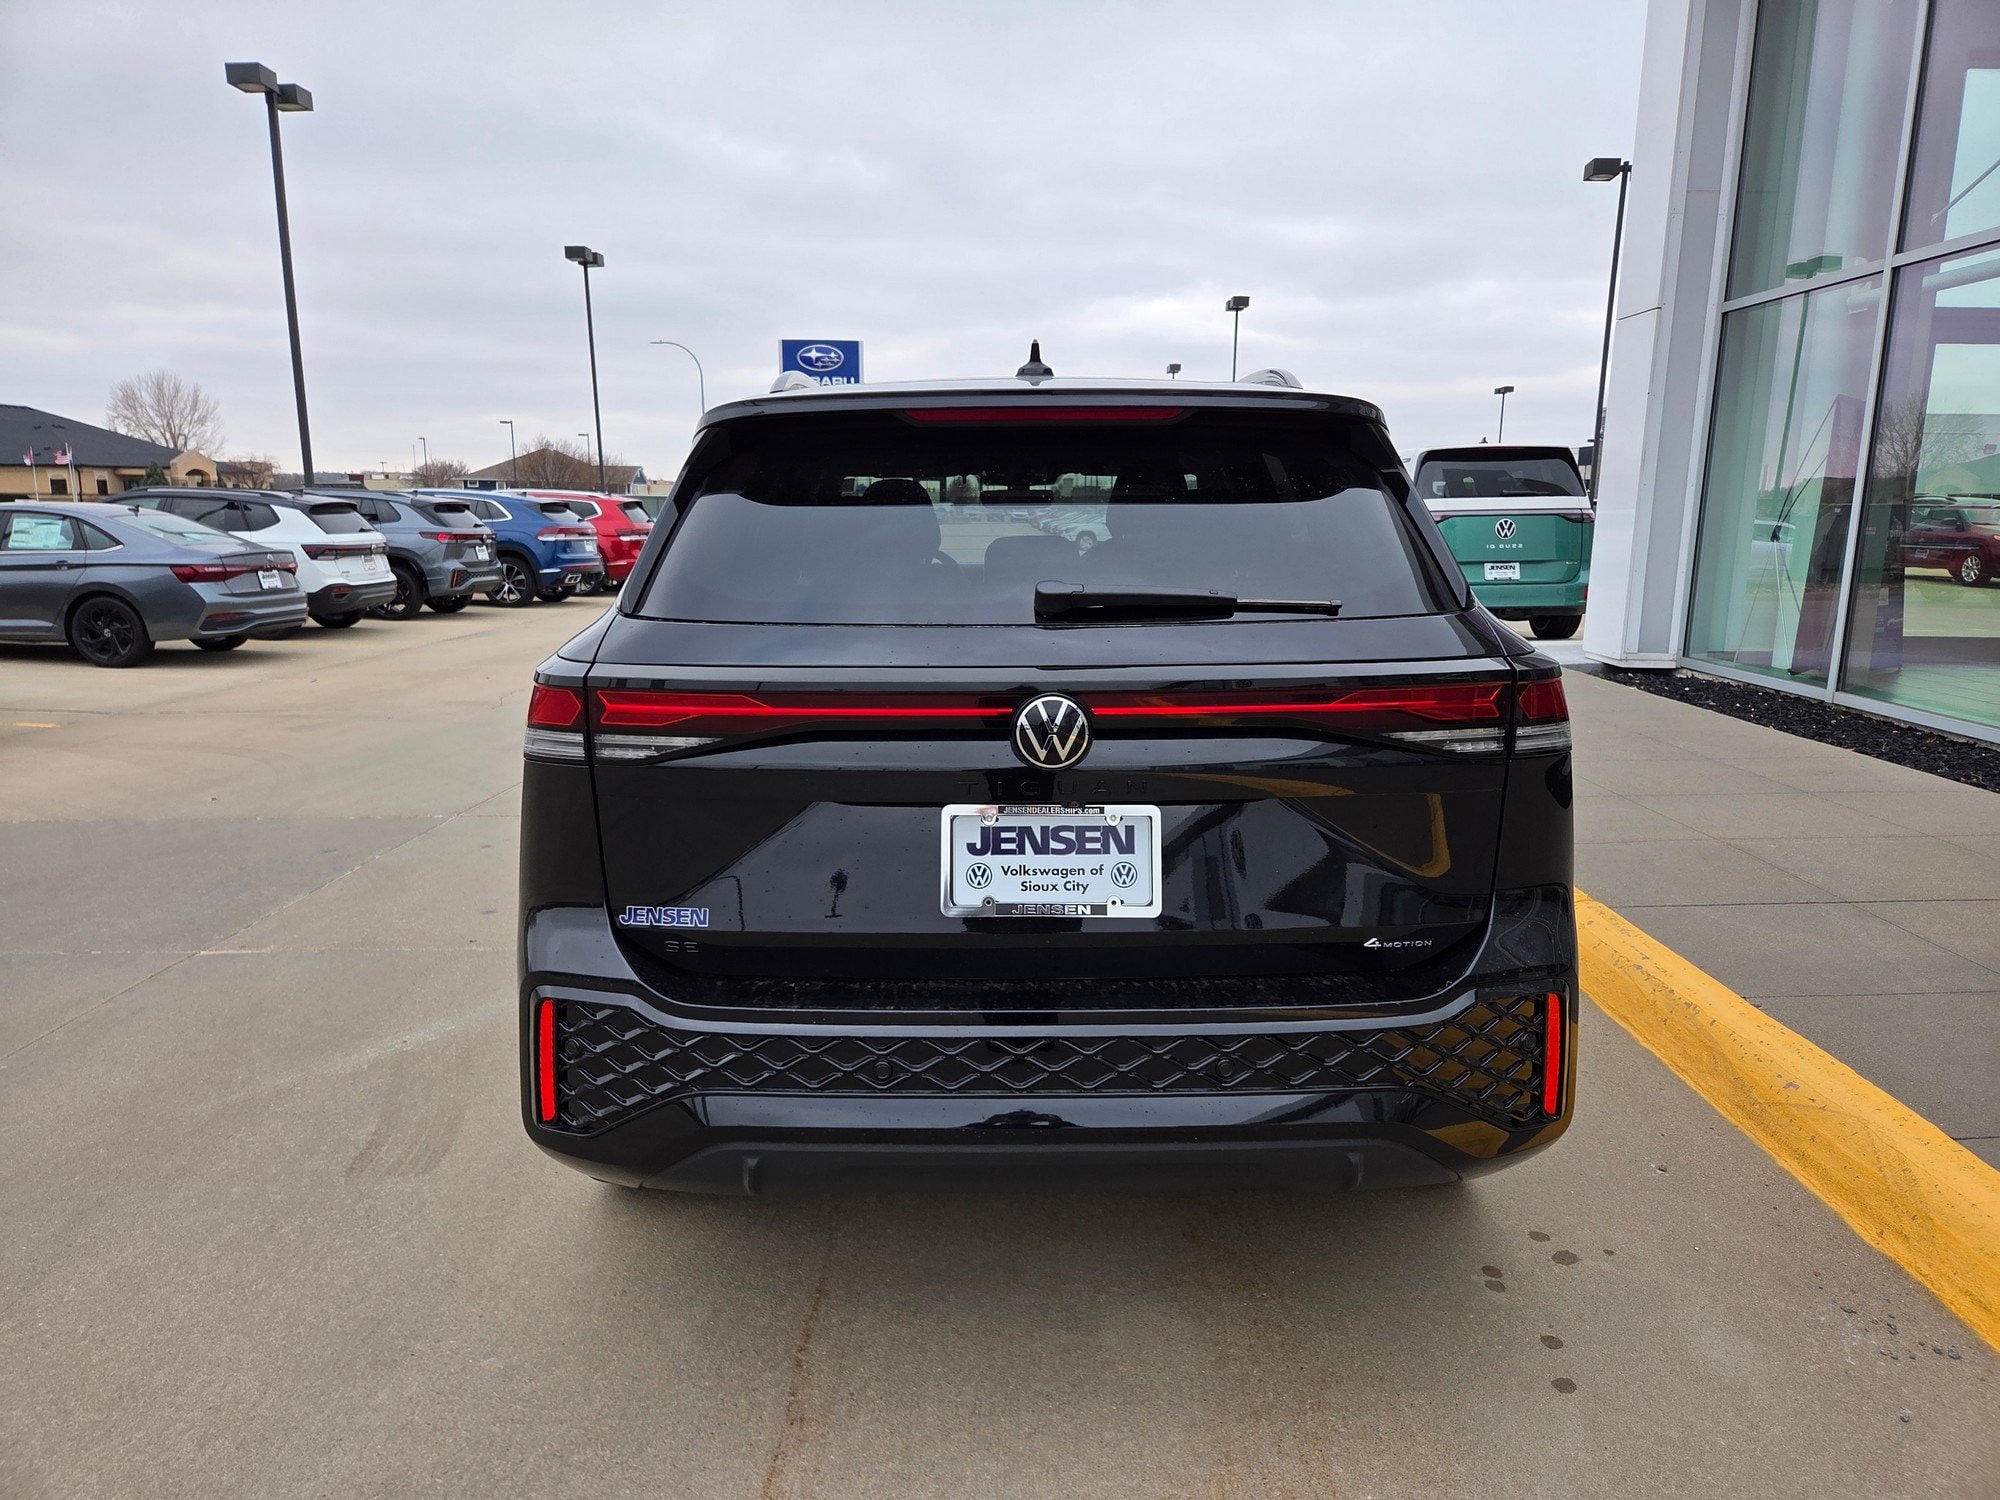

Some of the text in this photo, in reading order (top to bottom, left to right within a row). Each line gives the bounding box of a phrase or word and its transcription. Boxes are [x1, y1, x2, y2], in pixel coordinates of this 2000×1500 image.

[958, 780, 1147, 797] TIGUAN
[966, 825, 1135, 856] JENSEN
[1001, 864, 1104, 879] Volkswagen of
[1020, 881, 1090, 895] Sioux City
[620, 906, 709, 927] JENSEN
[1012, 904, 1091, 915] JENSEN
[665, 940, 699, 953] SE
